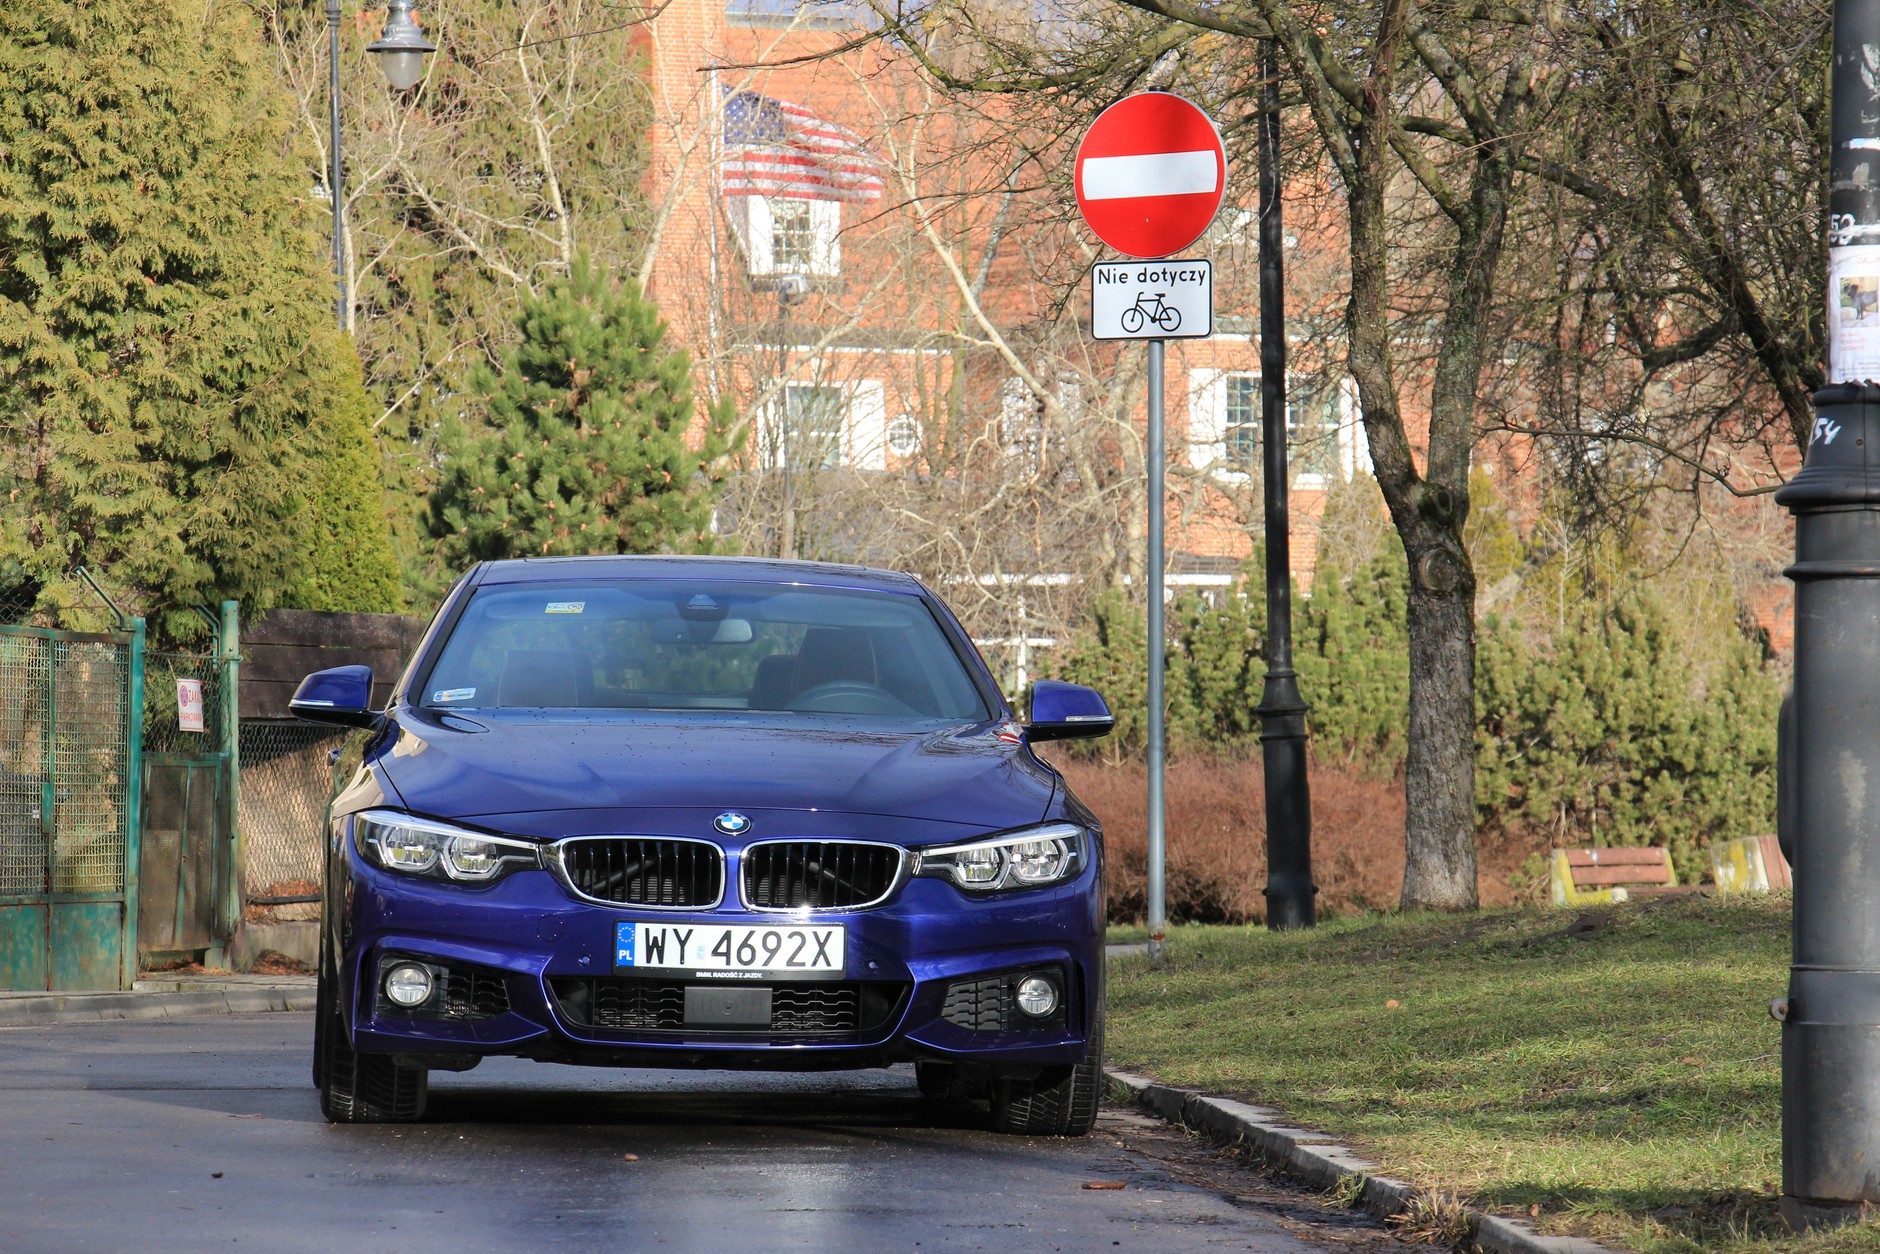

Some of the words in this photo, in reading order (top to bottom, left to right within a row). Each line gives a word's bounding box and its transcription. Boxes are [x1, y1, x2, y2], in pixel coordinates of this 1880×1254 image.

[1098, 268, 1129, 284] Nie
[1137, 267, 1207, 287] dotyczy
[618, 949, 633, 961] PL
[644, 927, 694, 965] WY
[711, 929, 833, 968] 4692X
